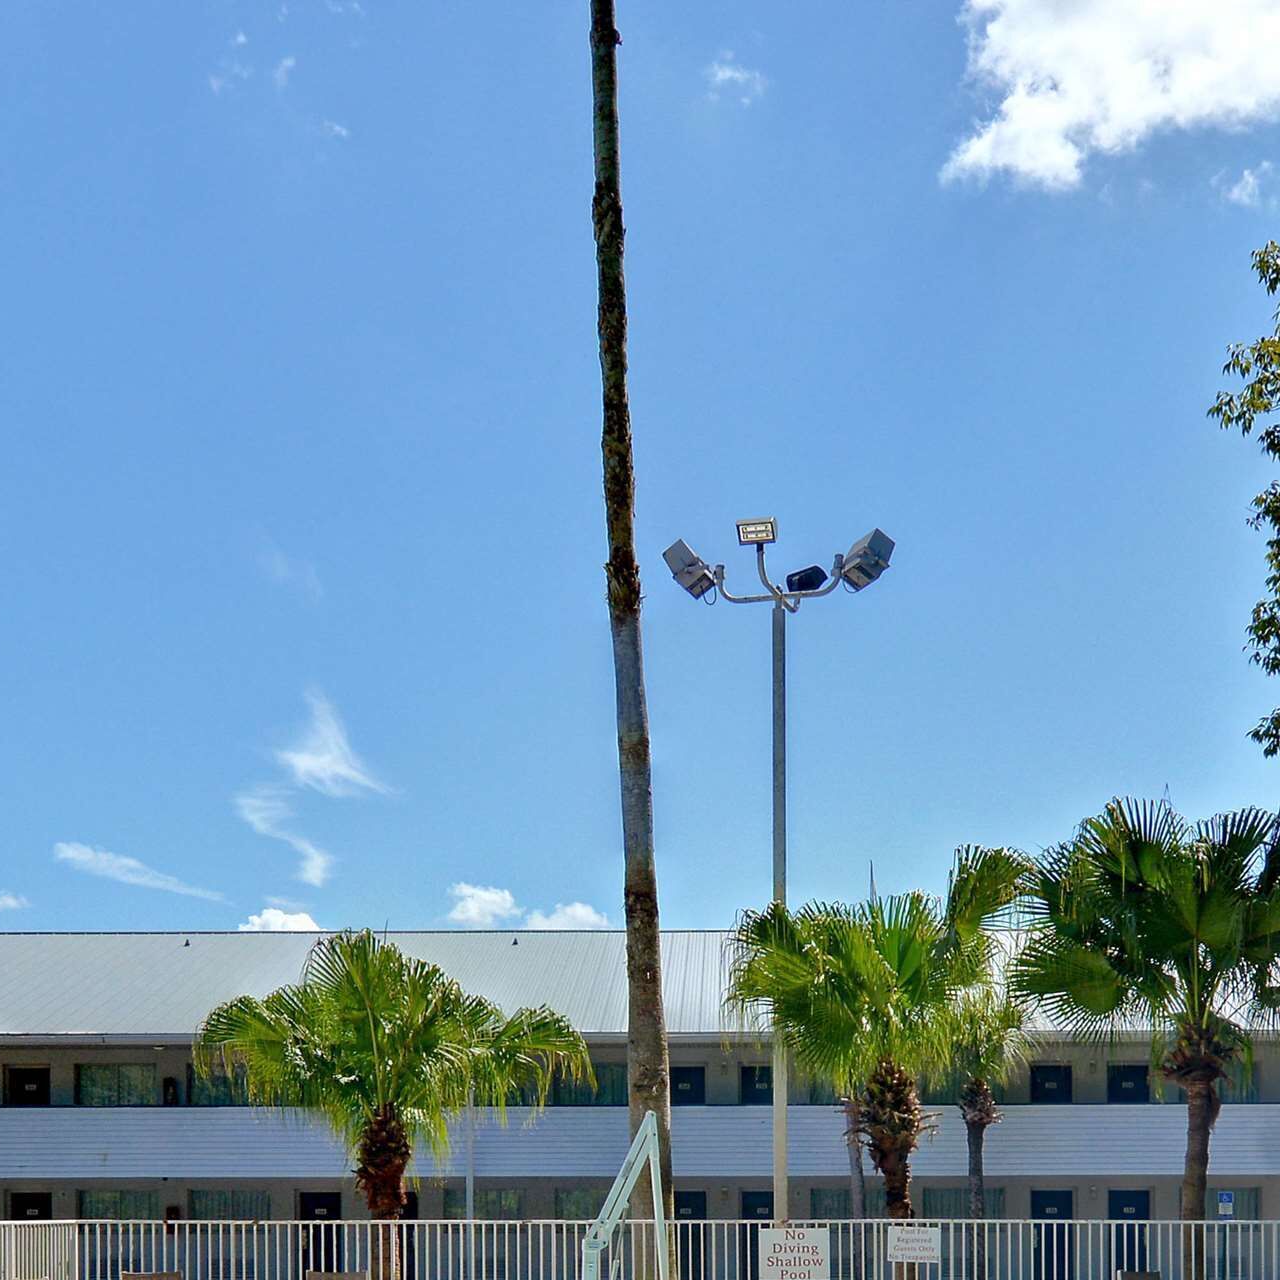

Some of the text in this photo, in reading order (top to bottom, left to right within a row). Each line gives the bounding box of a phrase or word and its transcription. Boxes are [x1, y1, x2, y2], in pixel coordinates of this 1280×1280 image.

[785, 1230, 805, 1240] No
[772, 1243, 819, 1255] Diving
[767, 1256, 823, 1267] Shallow
[780, 1269, 811, 1280] Pool
